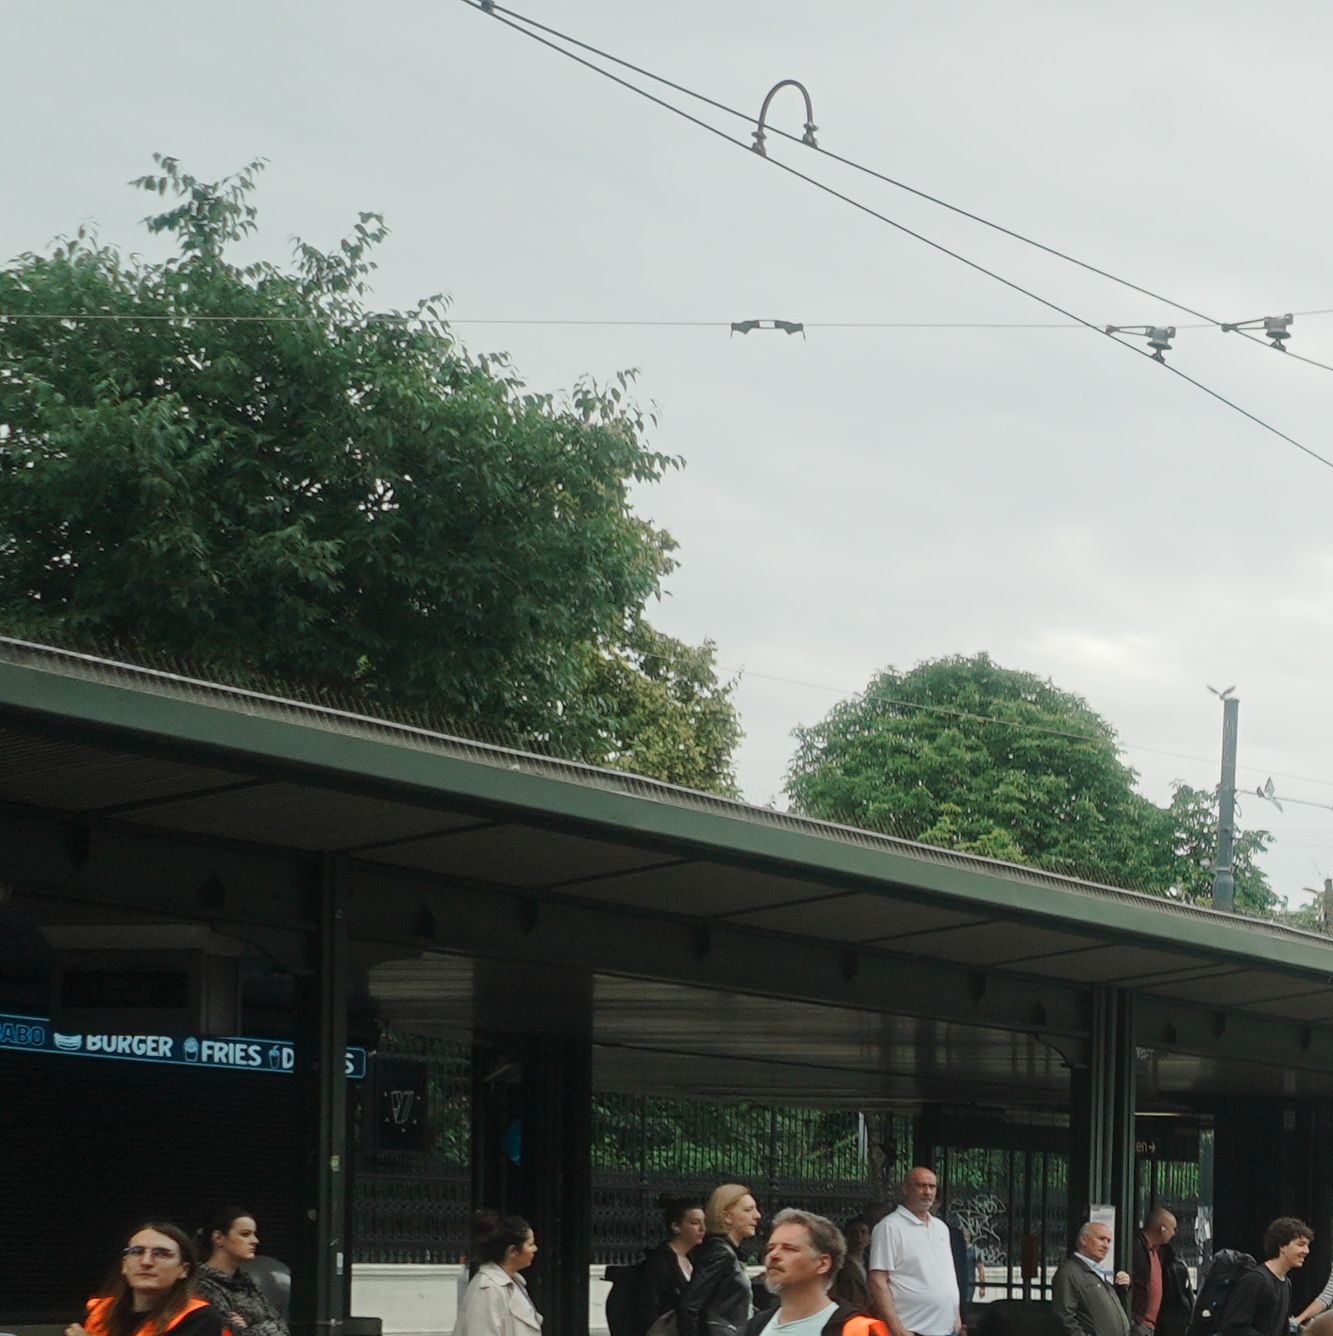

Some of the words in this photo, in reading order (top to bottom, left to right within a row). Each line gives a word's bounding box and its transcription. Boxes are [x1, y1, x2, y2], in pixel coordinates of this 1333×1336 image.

[0, 1023, 45, 1046] ABO
[86, 1034, 173, 1057] BURGER
[202, 1041, 262, 1066] FRIES
